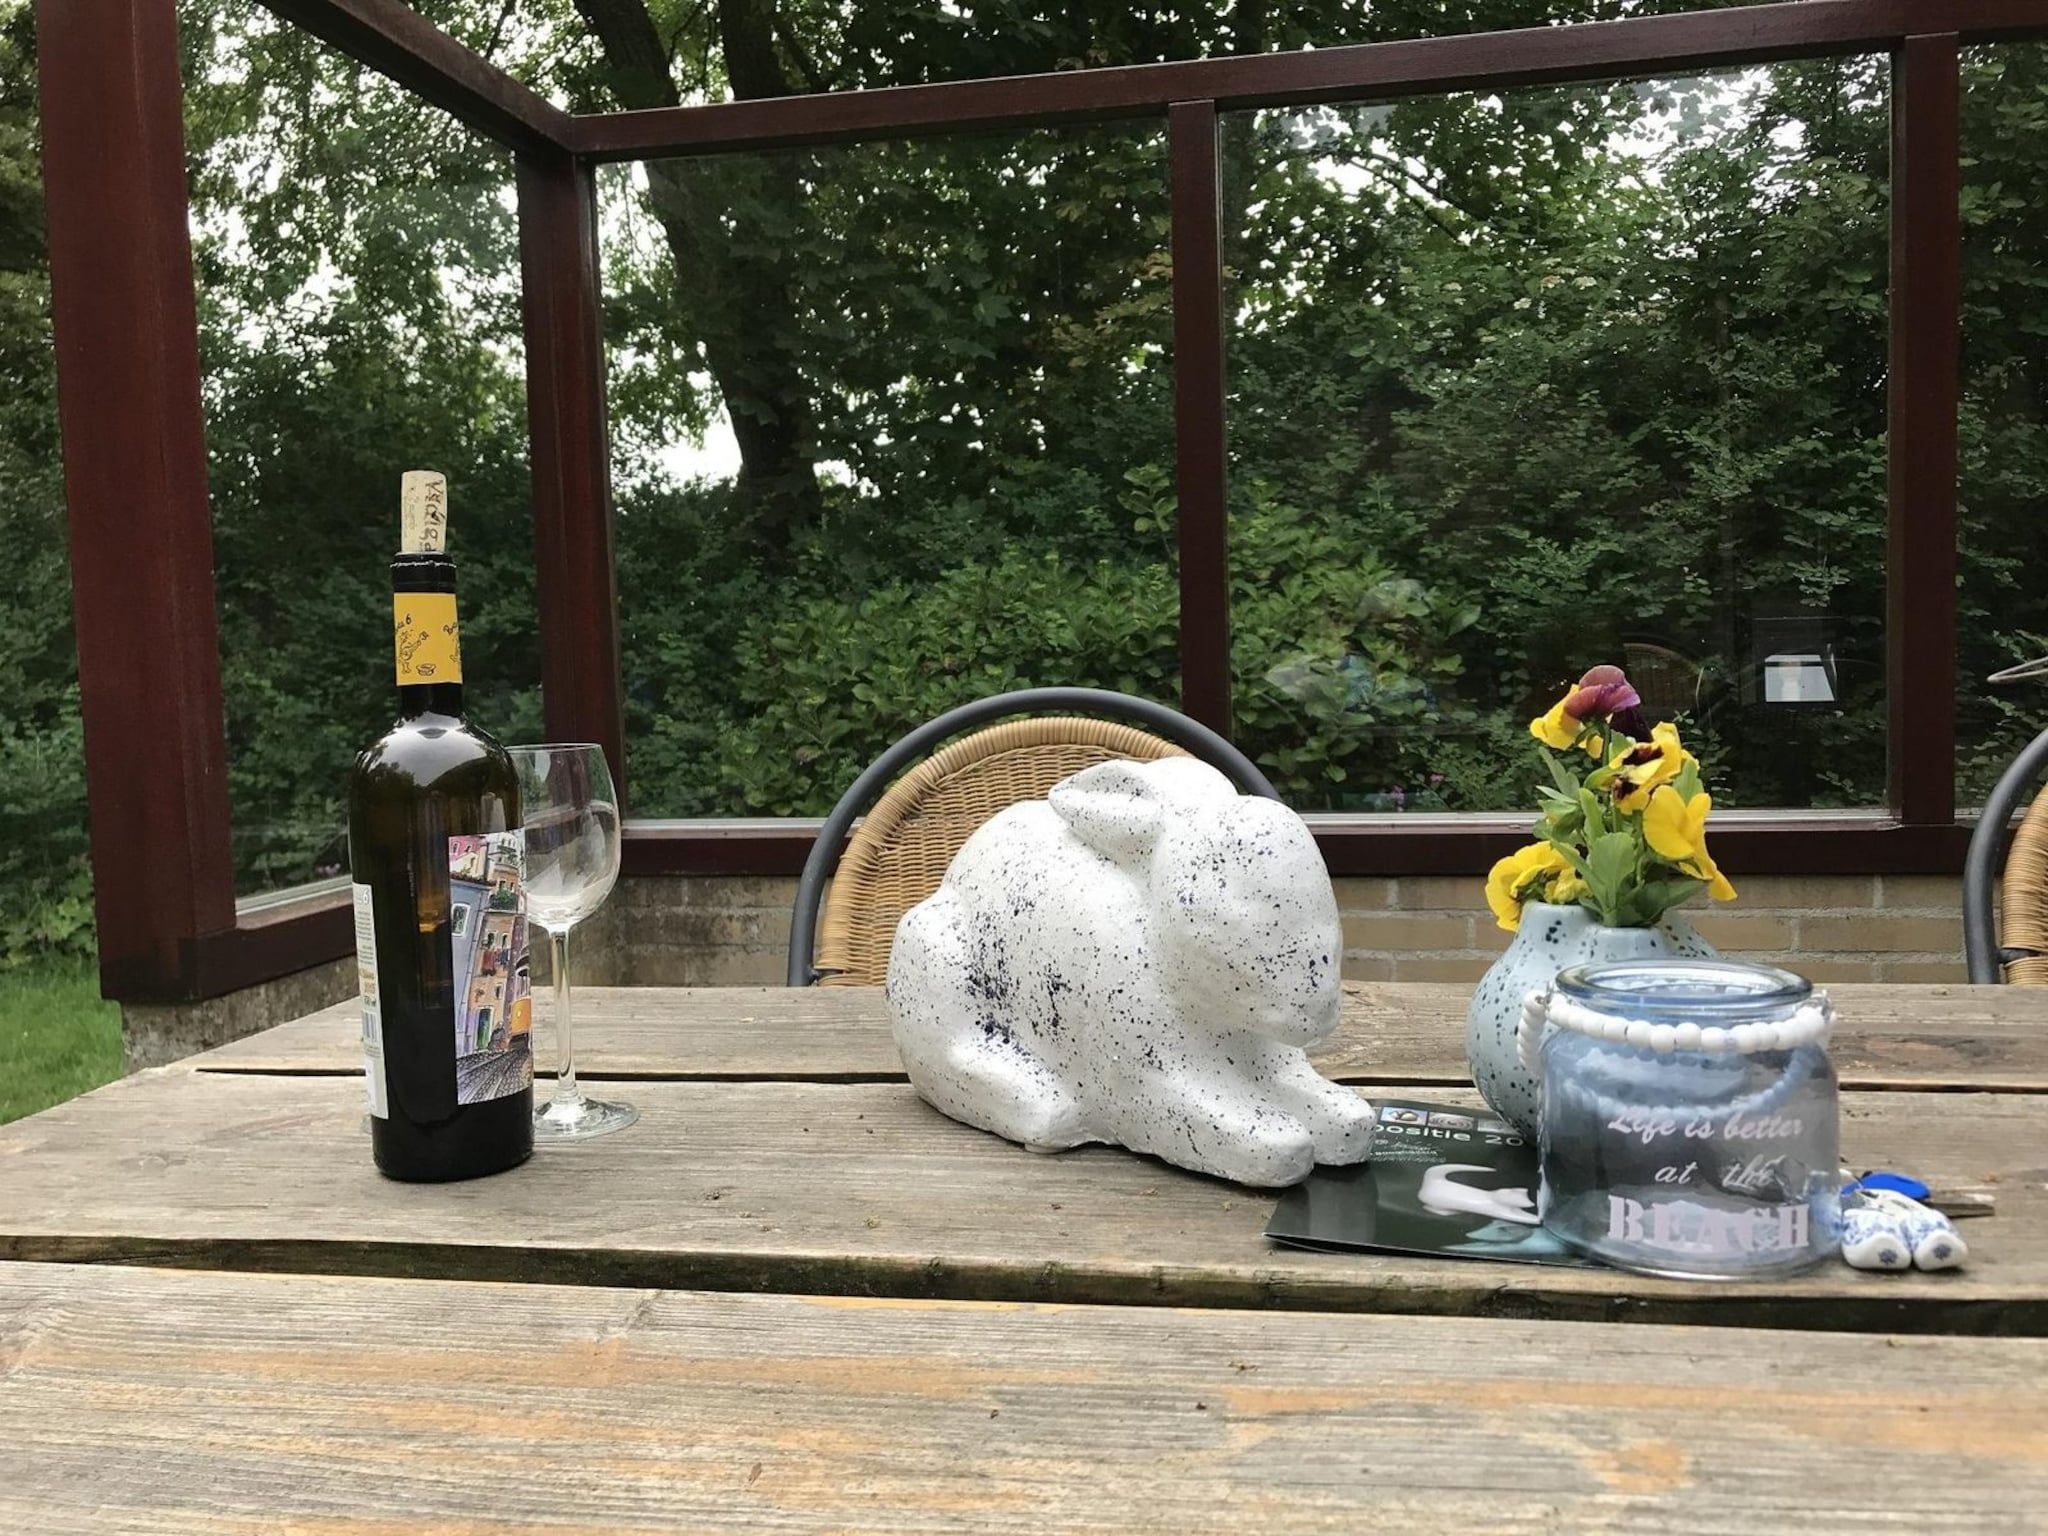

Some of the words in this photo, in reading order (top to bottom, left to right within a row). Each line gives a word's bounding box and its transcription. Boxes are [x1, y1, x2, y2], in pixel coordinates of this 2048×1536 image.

[1608, 1108, 1677, 1144] Life
[1684, 1114, 1714, 1139] is
[1723, 1109, 1804, 1140] better
[1654, 1161, 1699, 1185] at
[1722, 1154, 1776, 1188] the
[1608, 1194, 1810, 1251] BEACH
